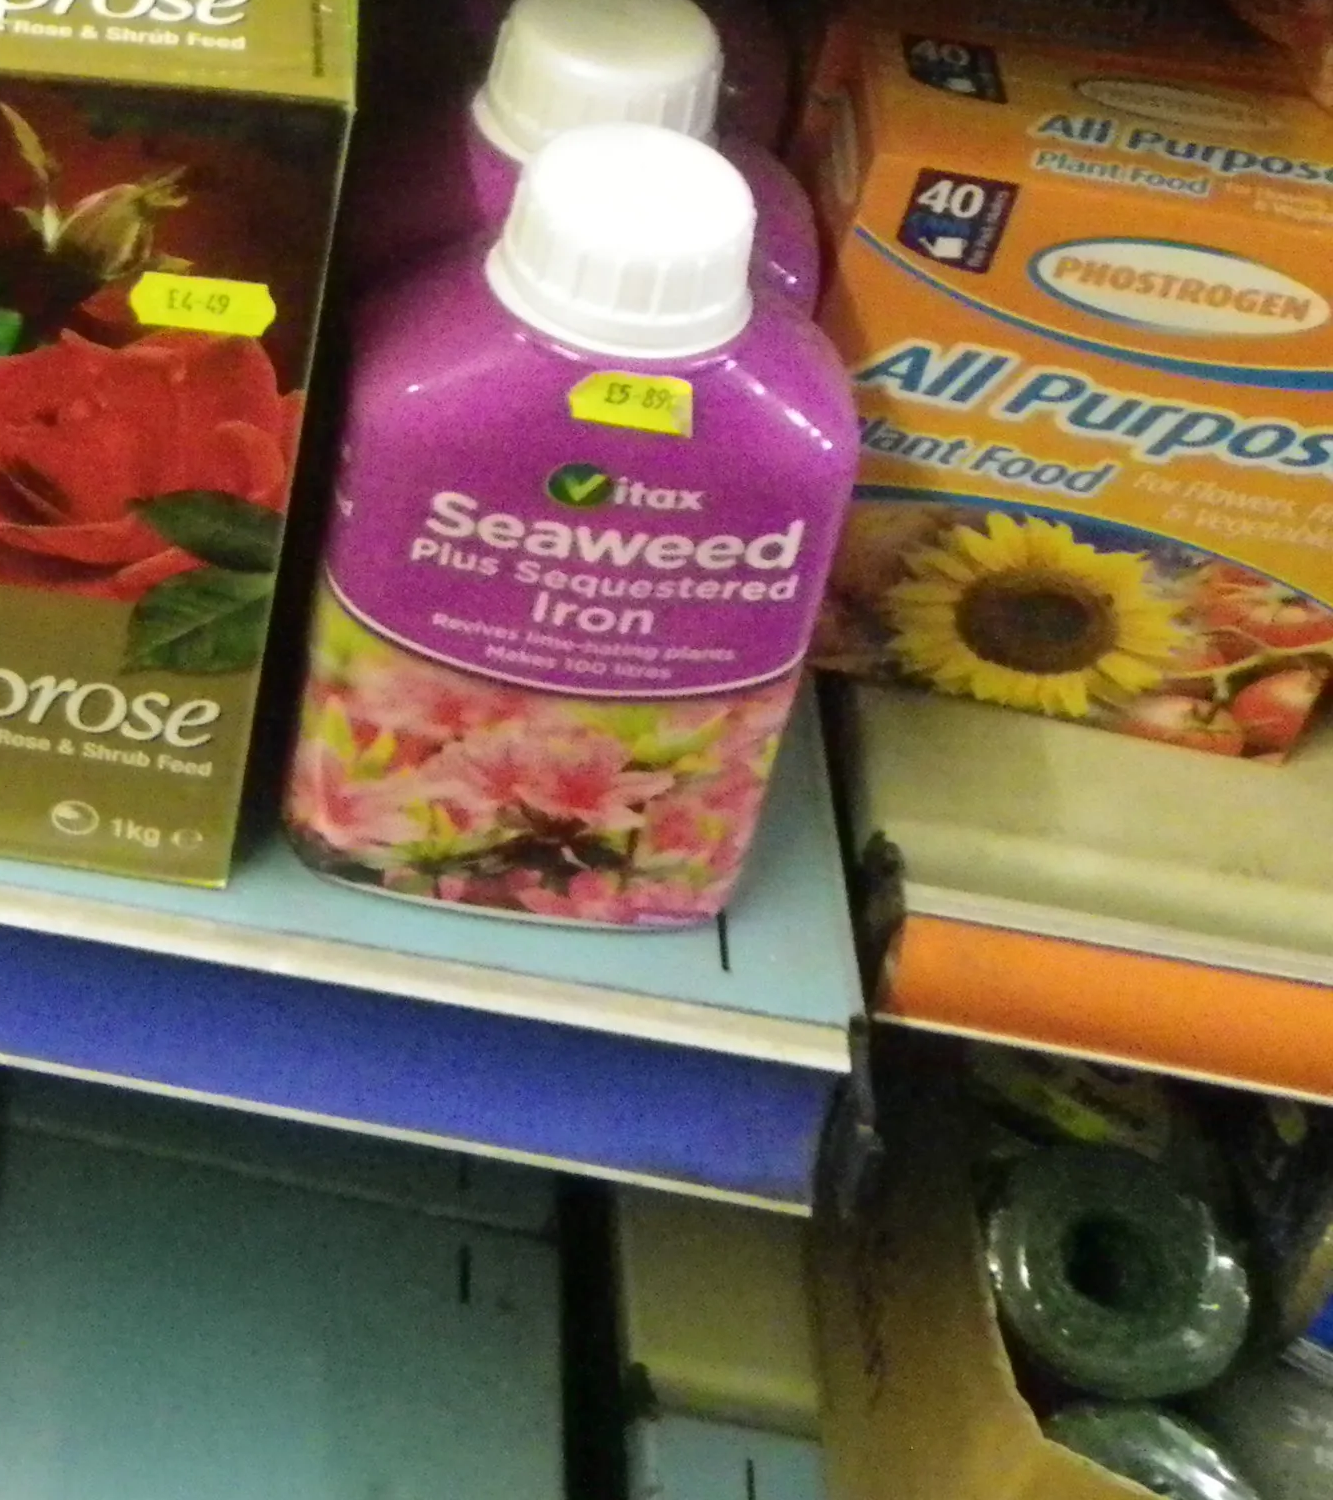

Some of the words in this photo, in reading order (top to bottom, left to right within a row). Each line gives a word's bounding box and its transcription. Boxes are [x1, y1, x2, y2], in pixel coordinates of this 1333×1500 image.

[11, 18, 74, 40] Rose
[79, 23, 98, 43] &
[106, 23, 182, 48] Shrub
[186, 30, 247, 52] Feed
[1033, 150, 1127, 185] Plant
[1129, 165, 1214, 196] Food
[918, 179, 985, 219] 40
[1050, 255, 1312, 324] PHOSTROGEN
[854, 344, 1011, 405] All
[860, 416, 966, 468] lant
[969, 445, 1117, 495] Food
[424, 489, 807, 571] Seaweed
[410, 536, 500, 579] Plus
[512, 555, 800, 602] Sequestered
[531, 590, 654, 636] Iron
[485, 644, 558, 669] Makes
[564, 657, 608, 675] 100
[56, 735, 75, 756] &
[82, 740, 150, 770] Shrub
[156, 753, 214, 779] Feed
[109, 815, 161, 850] 1kg
